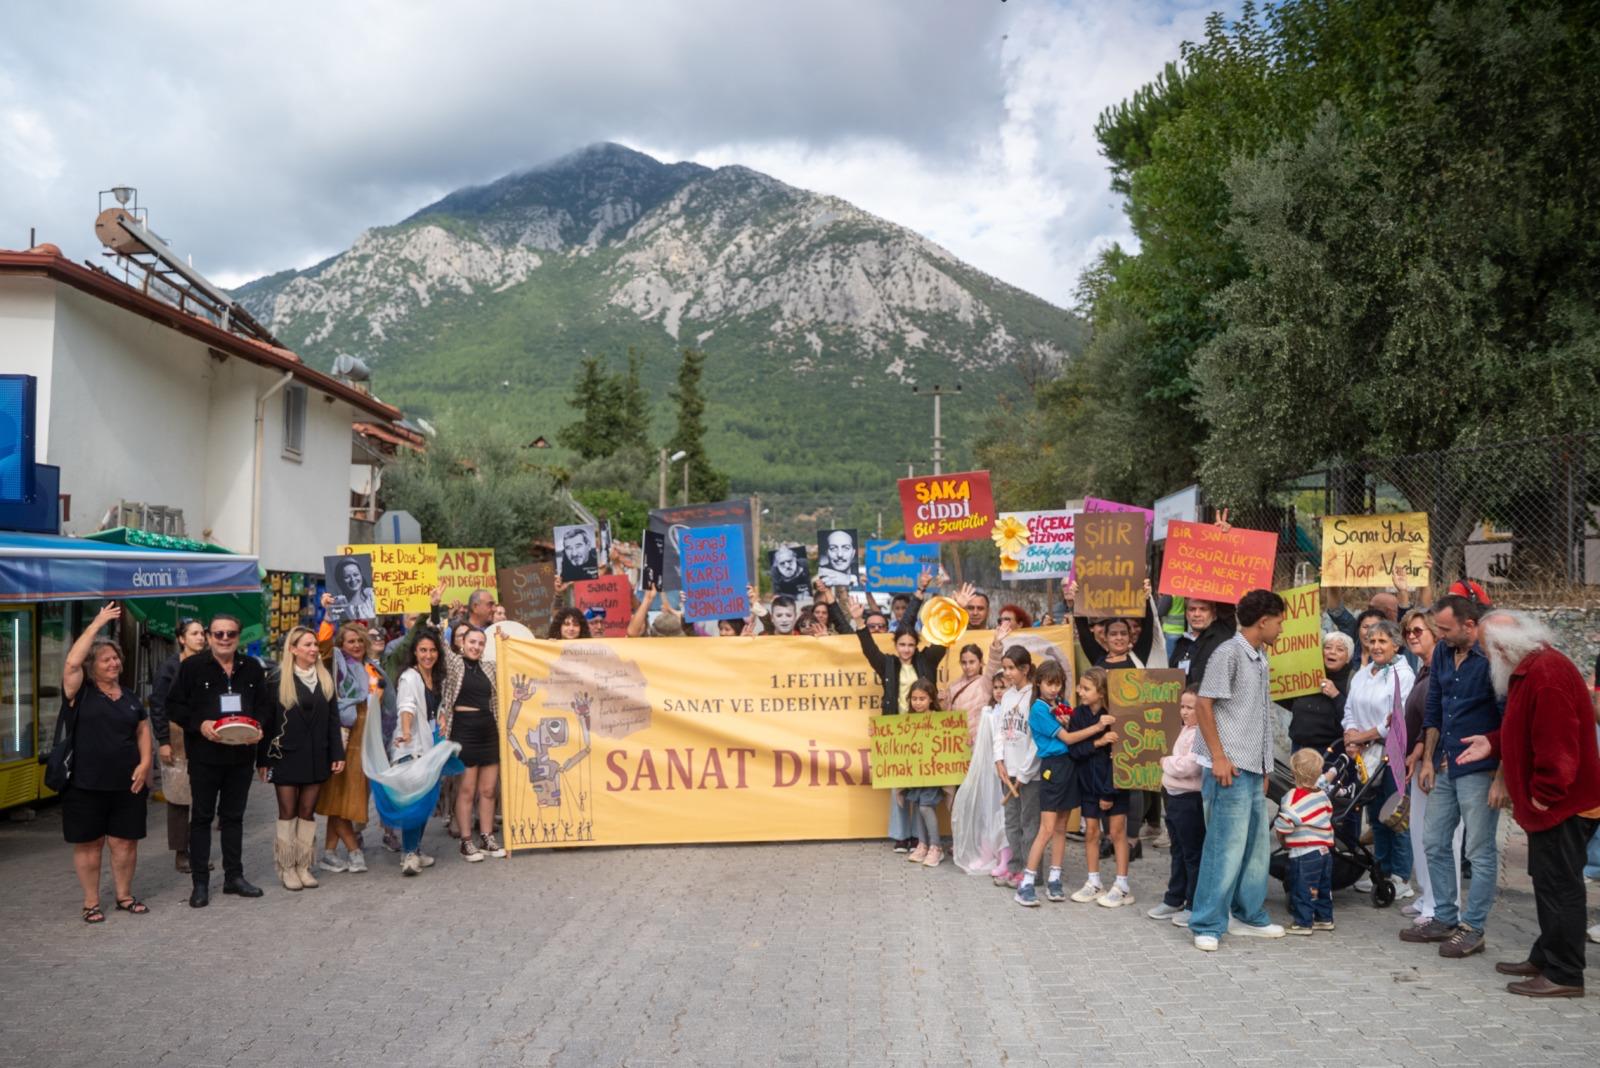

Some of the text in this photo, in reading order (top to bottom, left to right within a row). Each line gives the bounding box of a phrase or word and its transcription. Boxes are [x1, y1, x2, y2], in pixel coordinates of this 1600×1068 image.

[914, 479, 971, 504] ŞAKA
[917, 498, 970, 520] CİDDİ
[913, 520, 935, 538] Bir
[1027, 514, 1075, 534] ÇİÇEKL
[1334, 519, 1425, 546] Sanat Yoksa
[1026, 532, 1074, 545] ÇİZİYOR
[1344, 551, 1375, 579] Kan
[132, 568, 172, 587] ekomini
[663, 698, 724, 713] SANAT
[730, 698, 755, 713] VE
[760, 693, 852, 713] EDEBİYAT
[605, 747, 756, 792] SANAT
